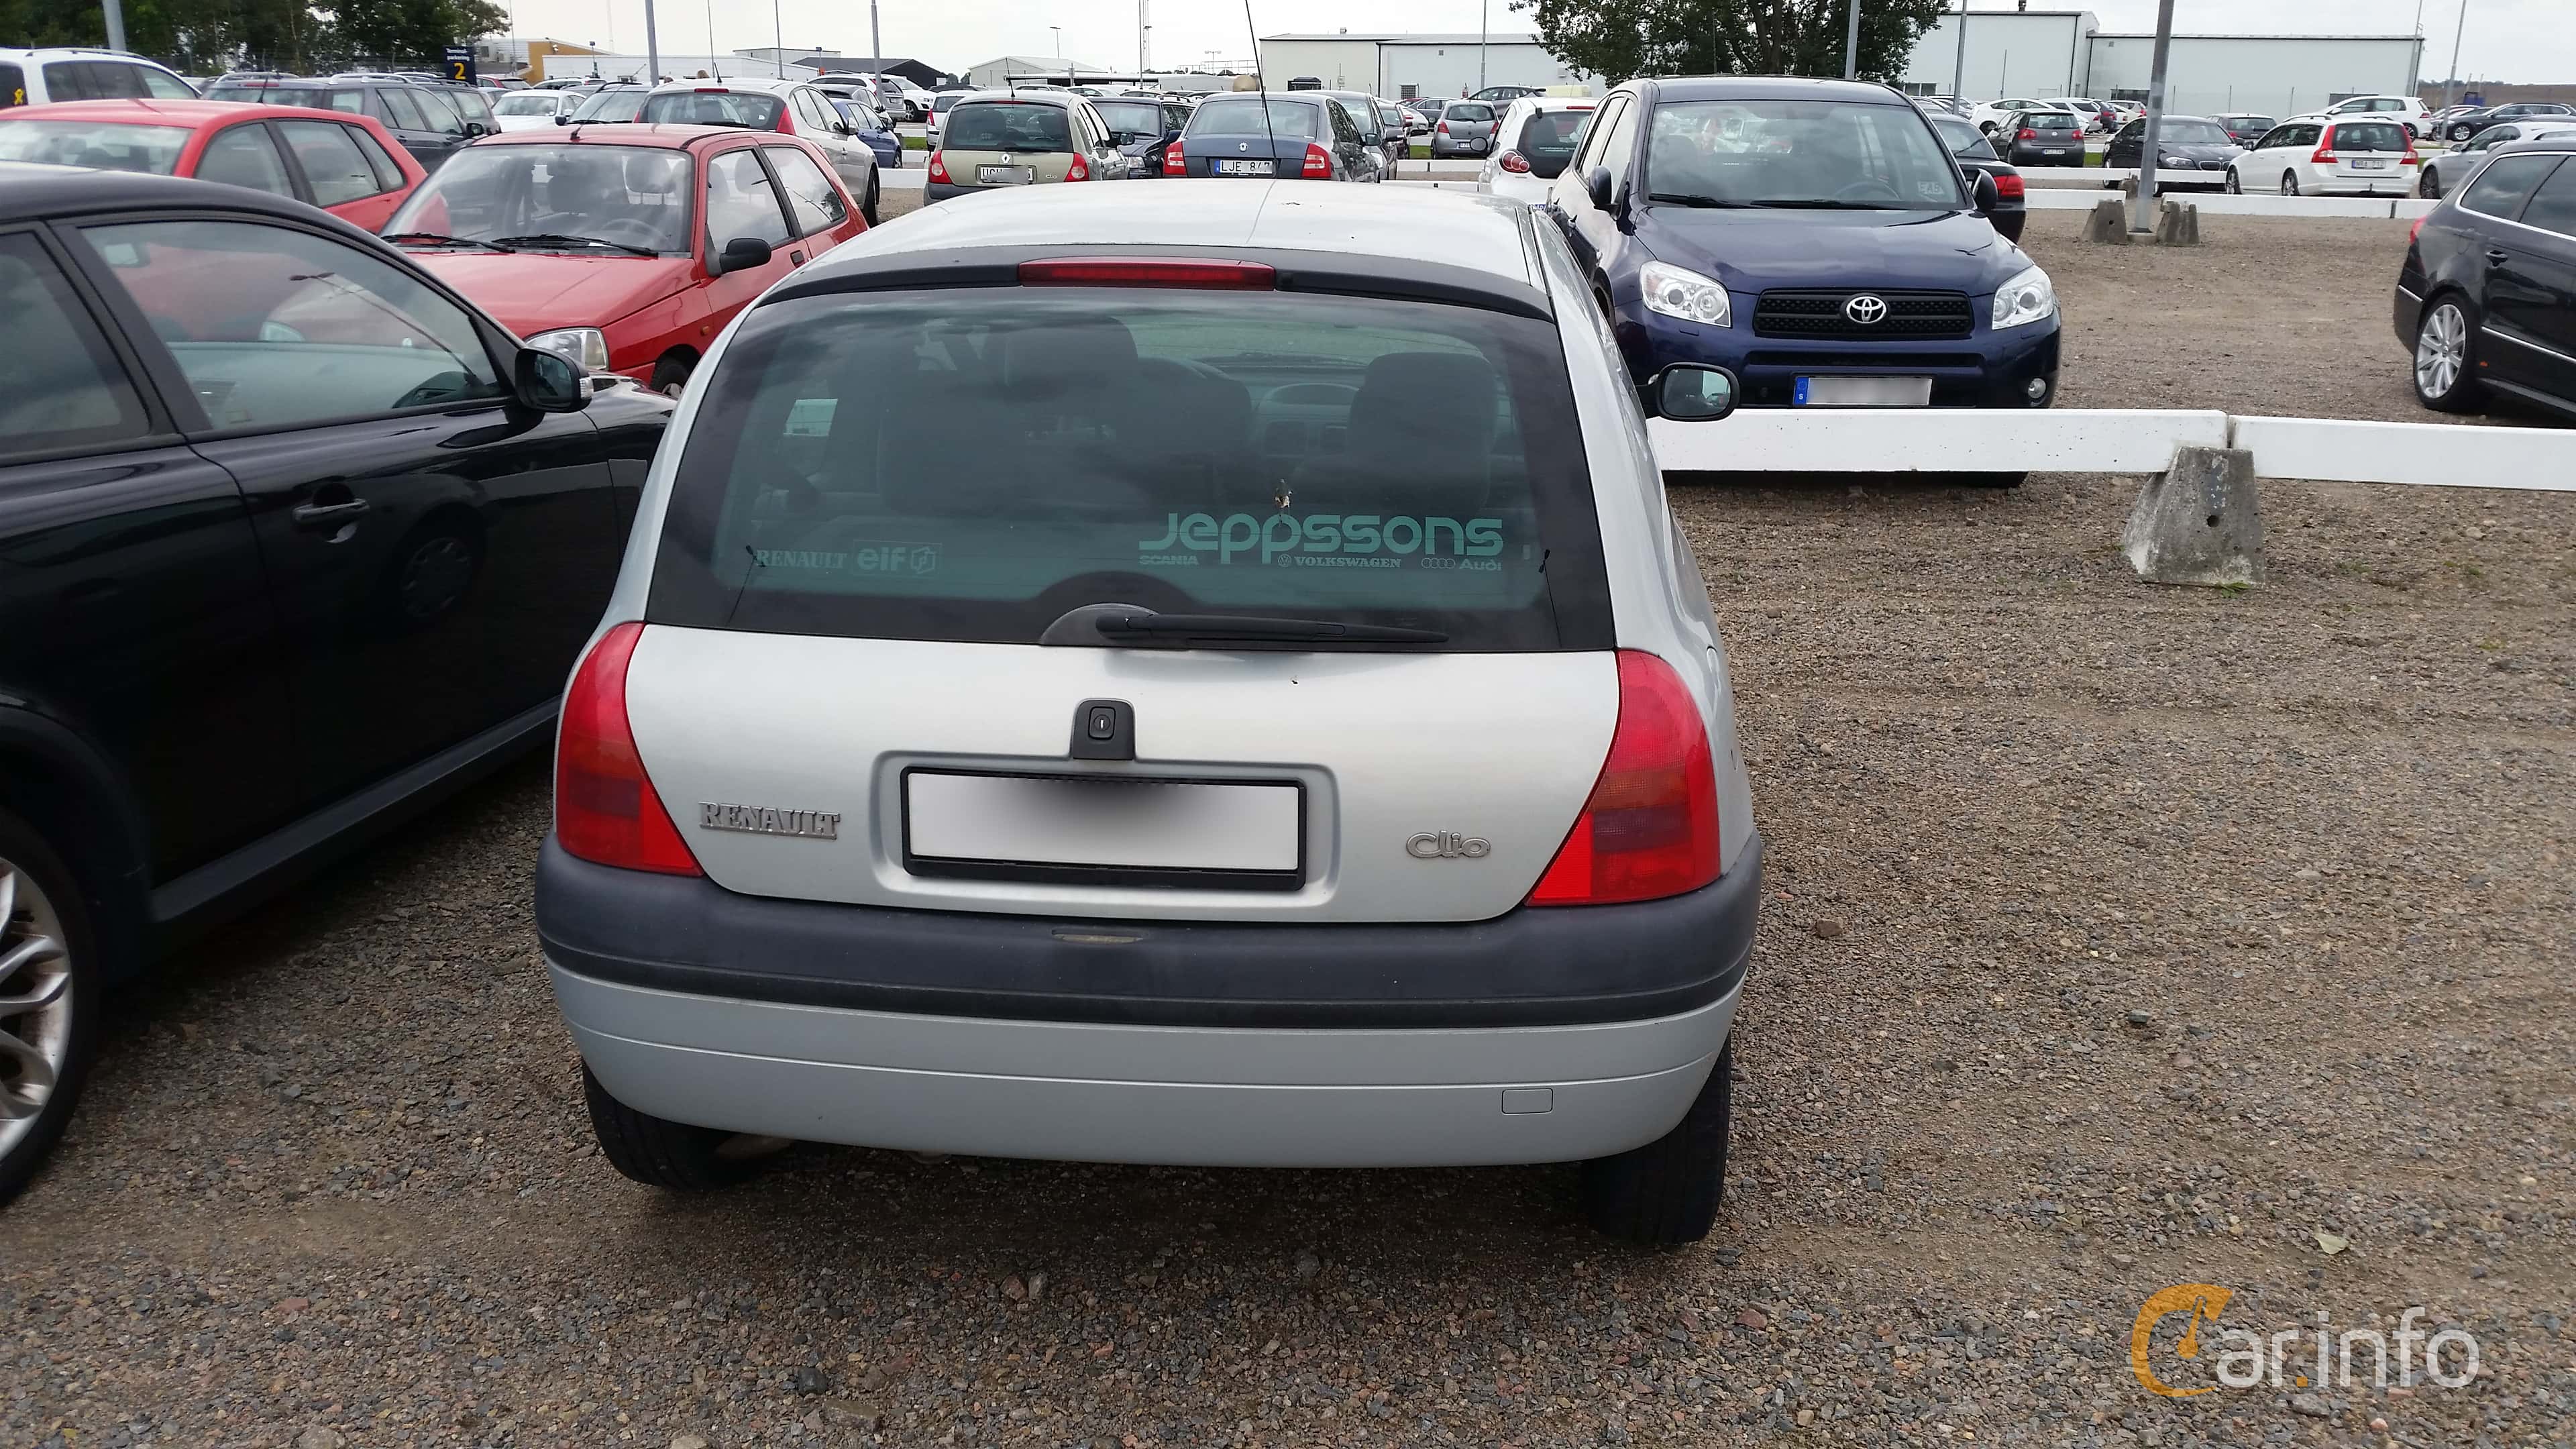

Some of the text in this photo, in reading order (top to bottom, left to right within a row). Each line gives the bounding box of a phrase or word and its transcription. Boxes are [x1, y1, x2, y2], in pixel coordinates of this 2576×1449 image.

[453, 62, 466, 79] 2
[1222, 161, 1242, 172] LJE
[1139, 513, 1503, 564] Jeppssons
[756, 547, 906, 571] RENAULT elf
[1139, 555, 1199, 565] SCANIA
[1294, 556, 1401, 568] VOLKSWAGEN
[1459, 558, 1502, 571] Audi
[698, 801, 840, 840] RENAULT
[1406, 829, 1491, 859] Clio
